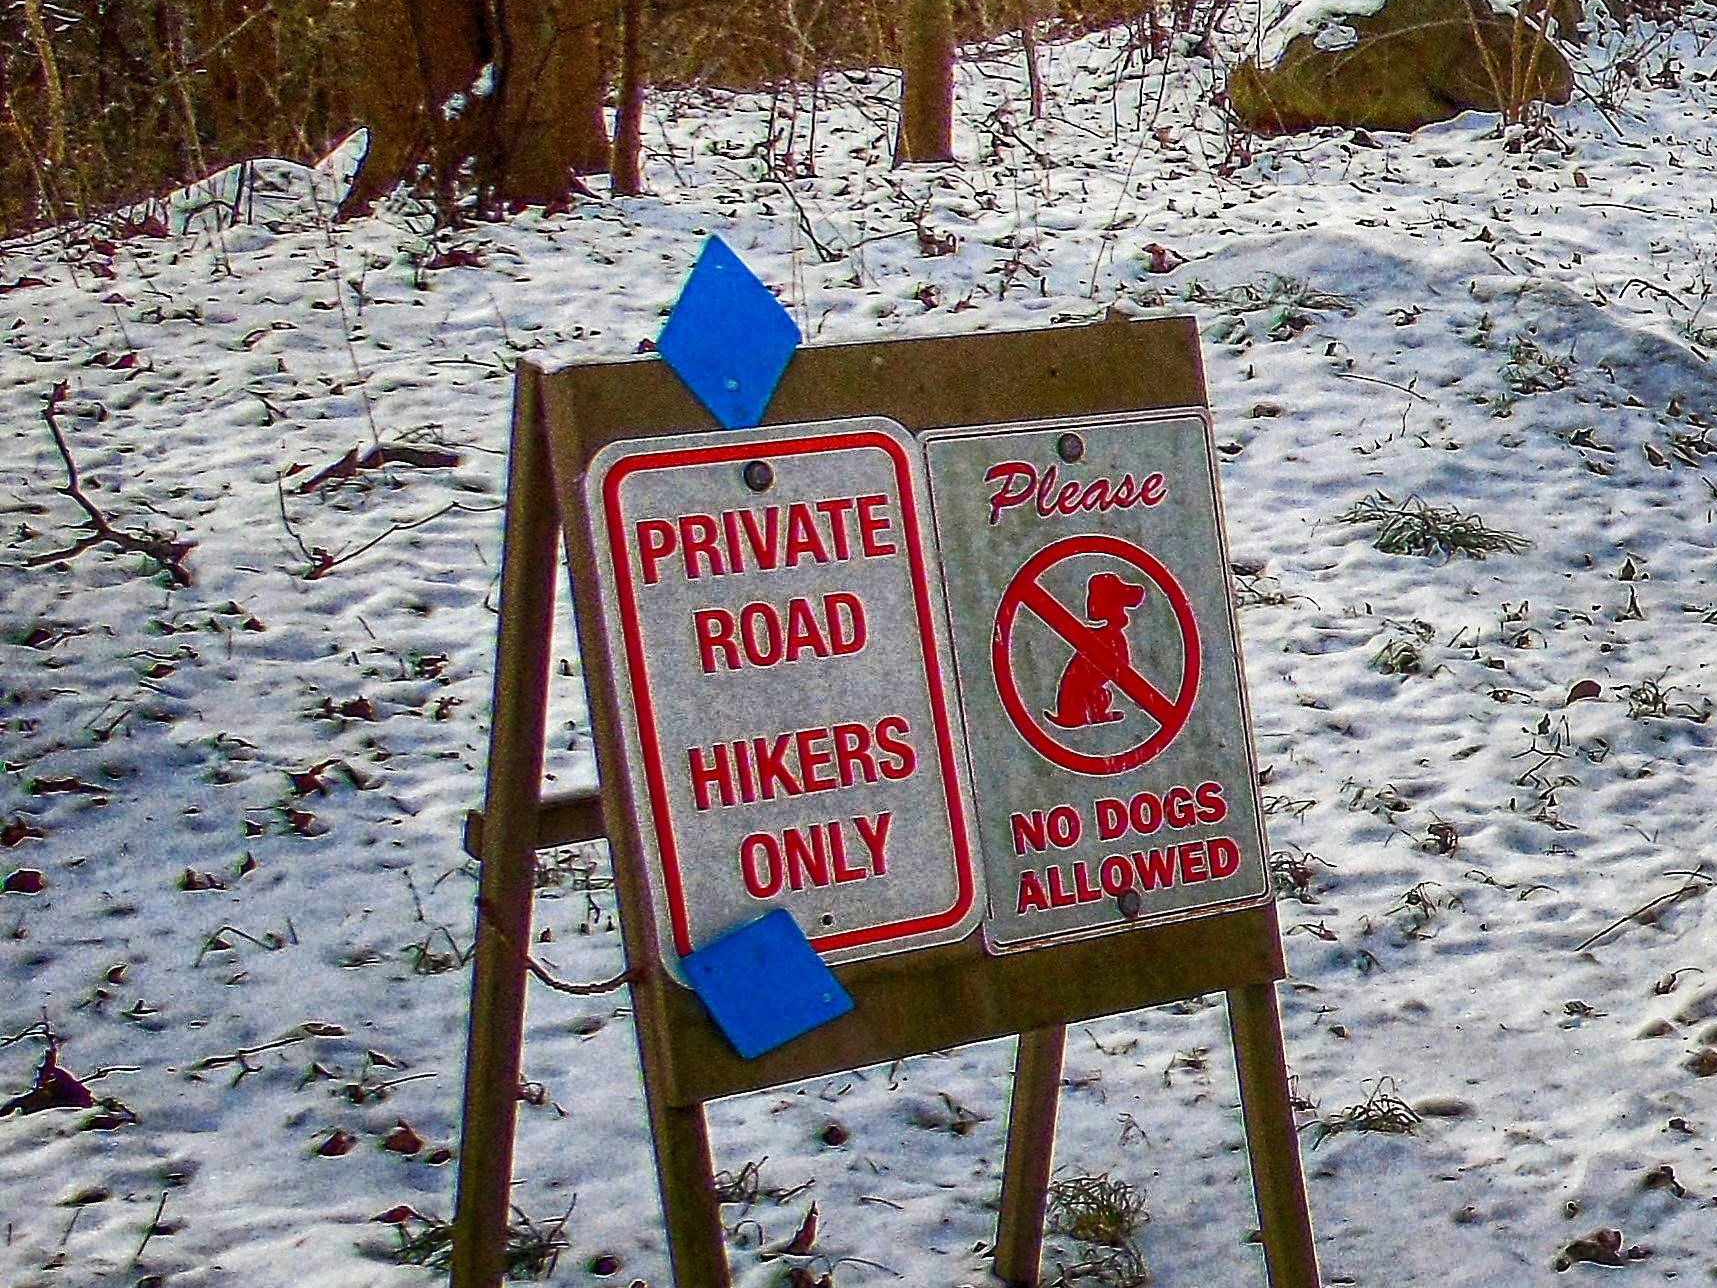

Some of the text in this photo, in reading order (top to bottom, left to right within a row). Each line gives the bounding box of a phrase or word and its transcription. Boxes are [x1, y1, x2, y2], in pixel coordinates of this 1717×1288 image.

[985, 461, 1168, 526] Please
[635, 494, 898, 585] PRIVATE
[694, 592, 868, 674] ROAD
[689, 716, 917, 811] HIKERS
[739, 813, 892, 900] ONLY
[1010, 781, 1227, 854] NO DOGS
[1017, 836, 1242, 914] ALLOWED
